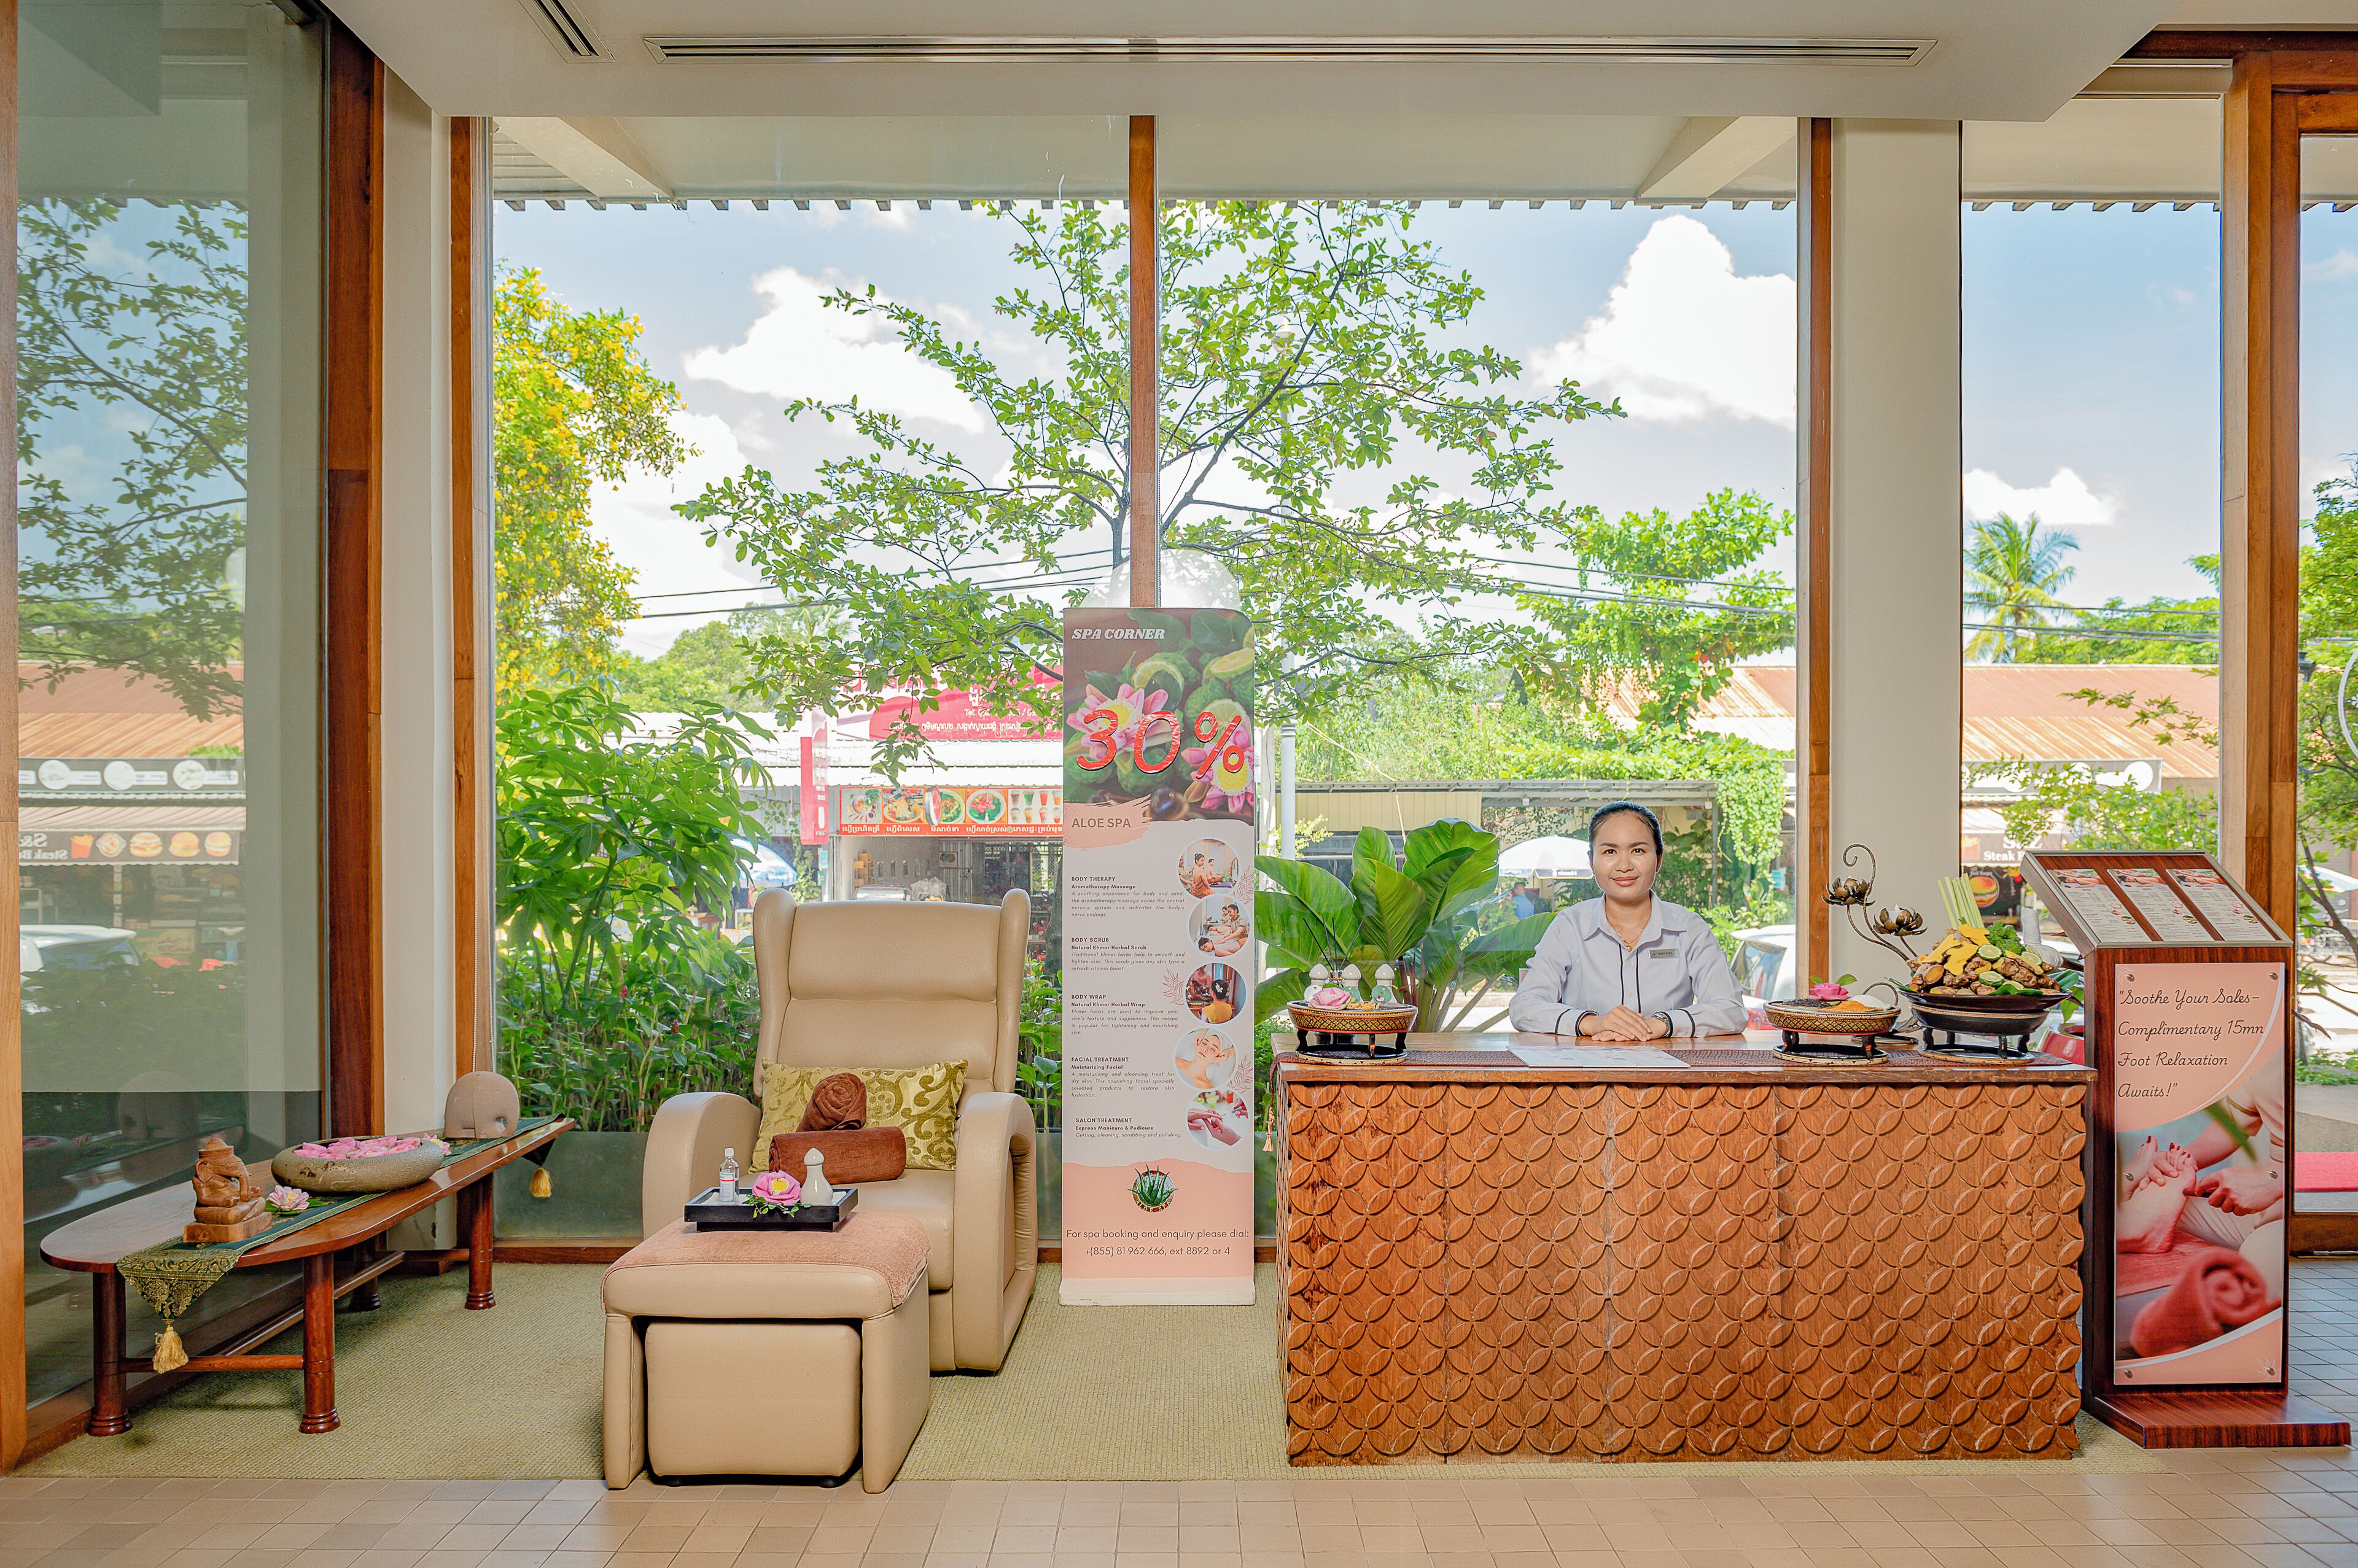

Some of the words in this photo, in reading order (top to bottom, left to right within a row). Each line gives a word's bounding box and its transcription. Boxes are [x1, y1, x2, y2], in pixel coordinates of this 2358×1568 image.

[1072, 629, 1102, 639] SPA
[1104, 629, 1165, 639] CORNER
[1076, 709, 1245, 779] 30%
[1072, 818, 1103, 828] ALOE
[1108, 818, 1130, 828] SPA
[1983, 850, 2015, 861] Steak
[2175, 989, 2208, 1010] Your
[2118, 1022, 2222, 1041] Complimentary
[2227, 1019, 2263, 1035] 15mn
[2118, 1052, 2150, 1067] Foot
[2155, 1051, 2227, 1066] Relaxation
[1067, 1229, 1081, 1238] For
[1103, 1229, 1138, 1240] booking
[1142, 1229, 1159, 1238] and
[1162, 1230, 1194, 1240] enquiry
[1197, 1229, 1227, 1240] please
[1230, 1229, 1249, 1238] dial:
[1085, 1246, 1114, 1257] +(855)
[1148, 1247, 1167, 1256] 666,
